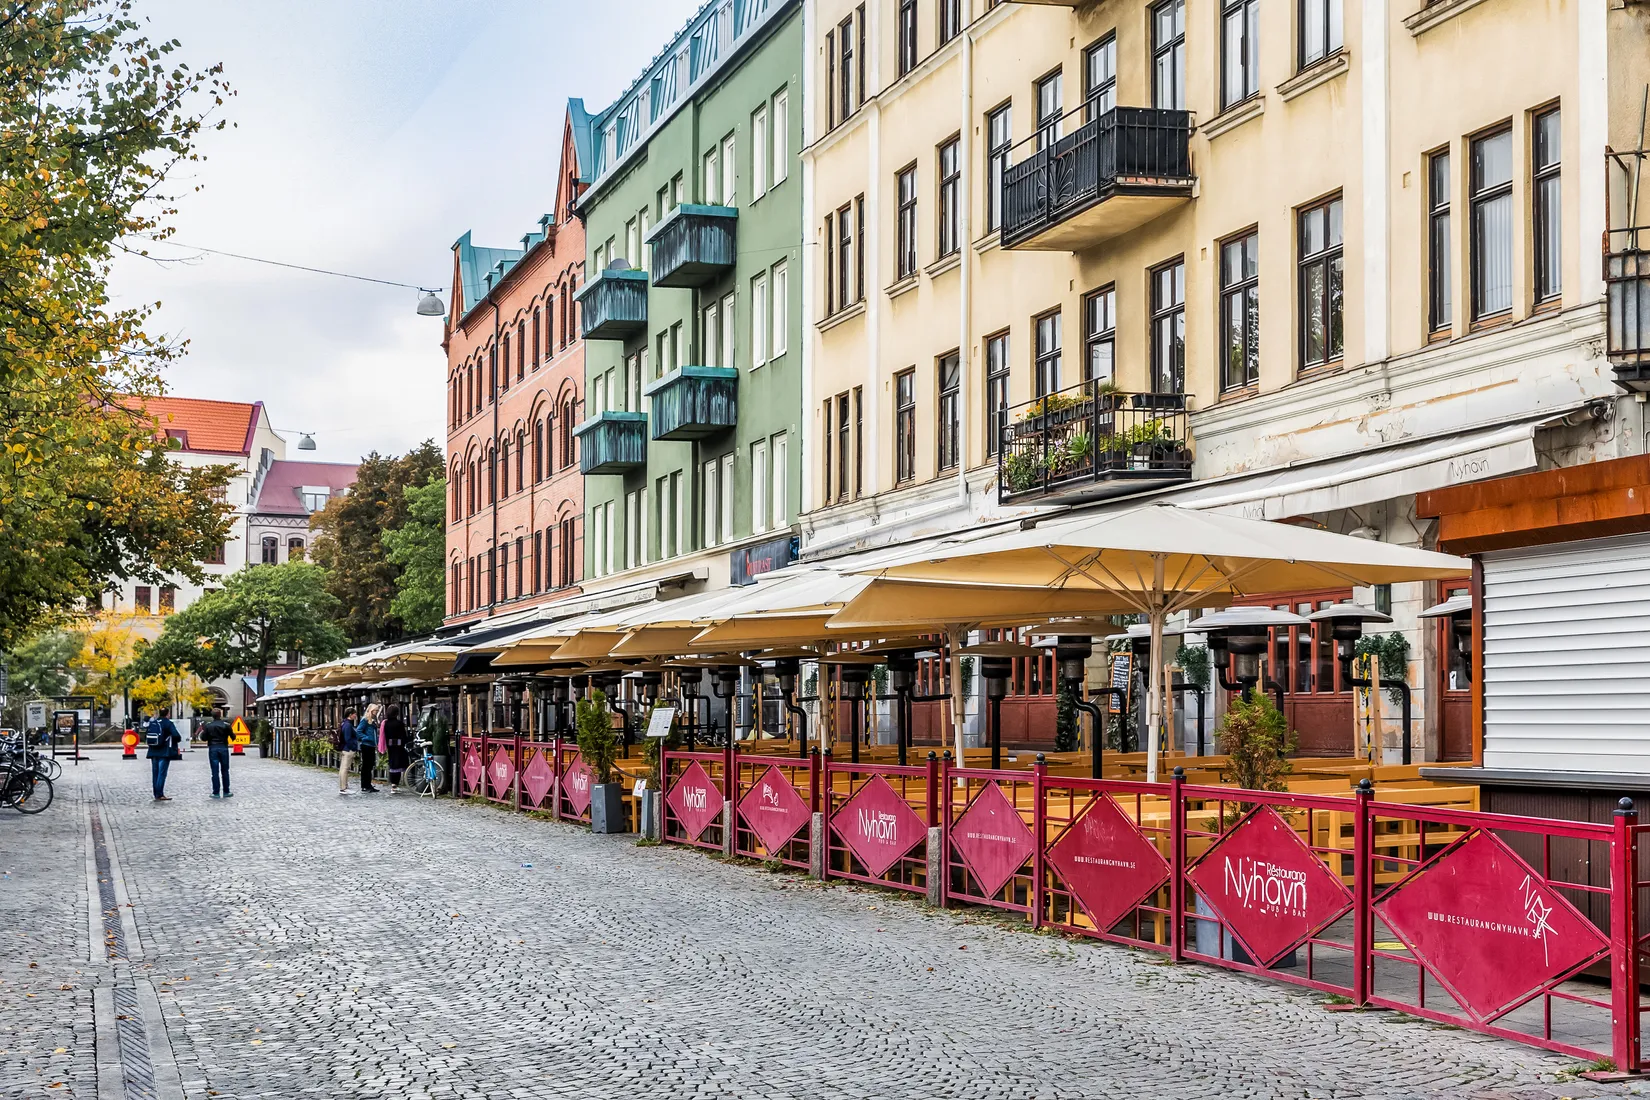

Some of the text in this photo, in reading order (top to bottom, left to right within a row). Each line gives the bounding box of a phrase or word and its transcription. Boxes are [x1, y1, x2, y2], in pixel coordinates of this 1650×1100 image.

[683, 785, 706, 812] Nyhavn
[858, 808, 897, 843] Nyhavn
[1074, 855, 1136, 869] WWW.RESTAURANGNYHAVN.SE
[1225, 856, 1307, 910] Nyhavn
[1266, 904, 1306, 918] PUB & BAR
[1427, 912, 1542, 939] WWW.RESTAURANGNYHAVN.SE
